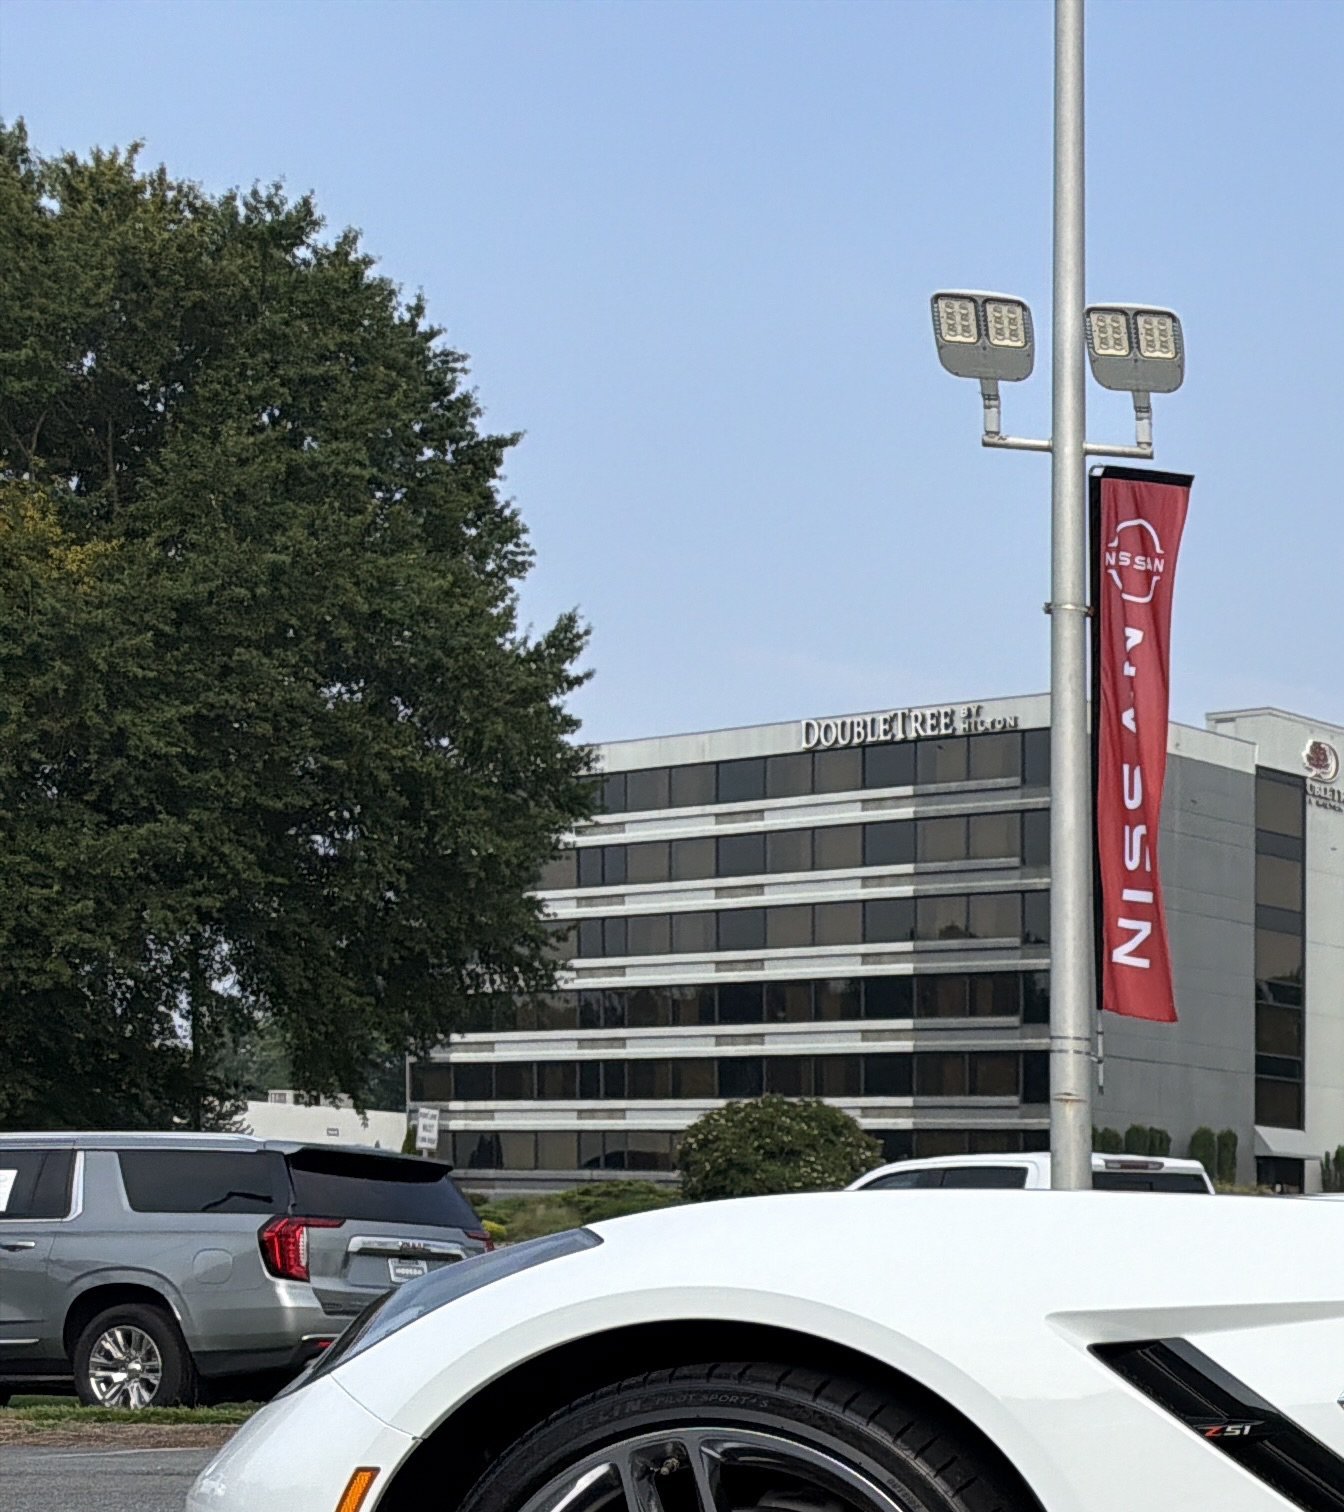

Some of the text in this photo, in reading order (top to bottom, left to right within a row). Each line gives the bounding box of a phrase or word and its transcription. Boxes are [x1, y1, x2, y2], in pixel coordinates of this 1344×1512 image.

[1105, 551, 1165, 573] NSSAN
[961, 704, 982, 719] BY
[801, 708, 954, 749] DOUBLETREE
[1200, 1424, 1251, 1437] Z51
